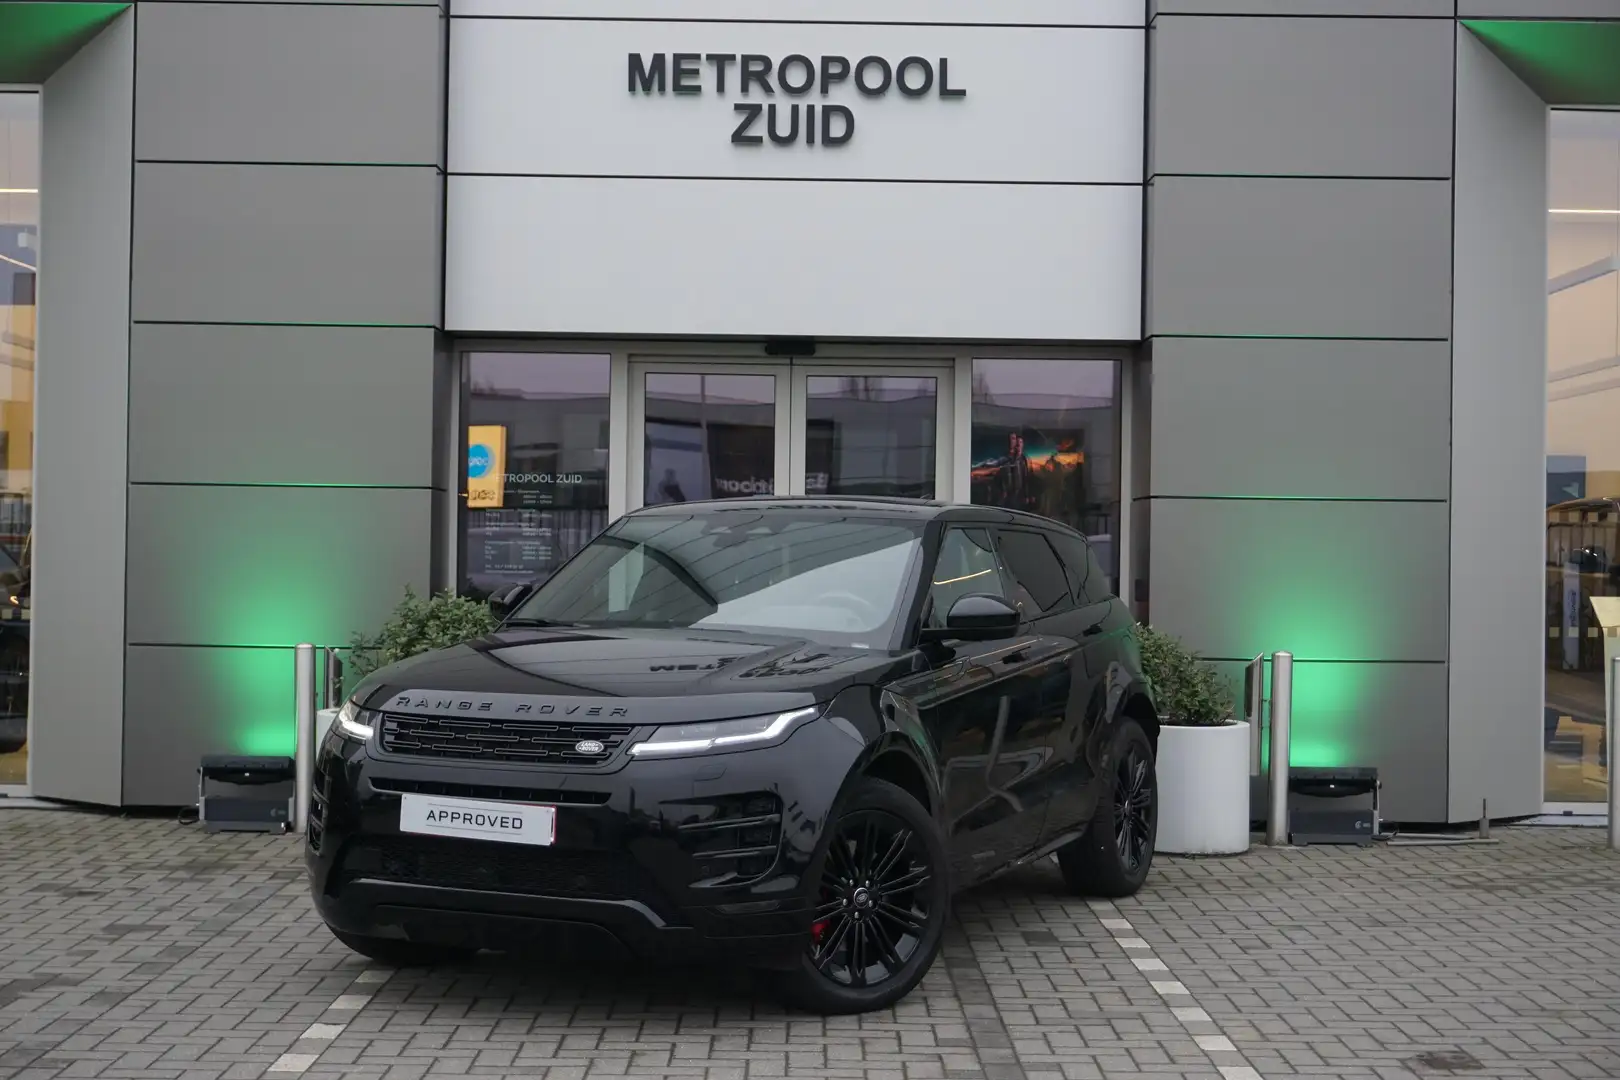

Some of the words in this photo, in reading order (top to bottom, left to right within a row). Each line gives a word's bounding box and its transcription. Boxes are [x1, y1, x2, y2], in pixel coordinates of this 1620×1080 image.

[627, 52, 967, 97] METROPOOL
[730, 103, 856, 146] ZUID
[493, 473, 554, 483] ETROPOOL
[556, 473, 583, 484] ZUID
[396, 696, 493, 712] RANGE
[515, 704, 628, 717] ROVER
[426, 809, 524, 831] APPROVED
